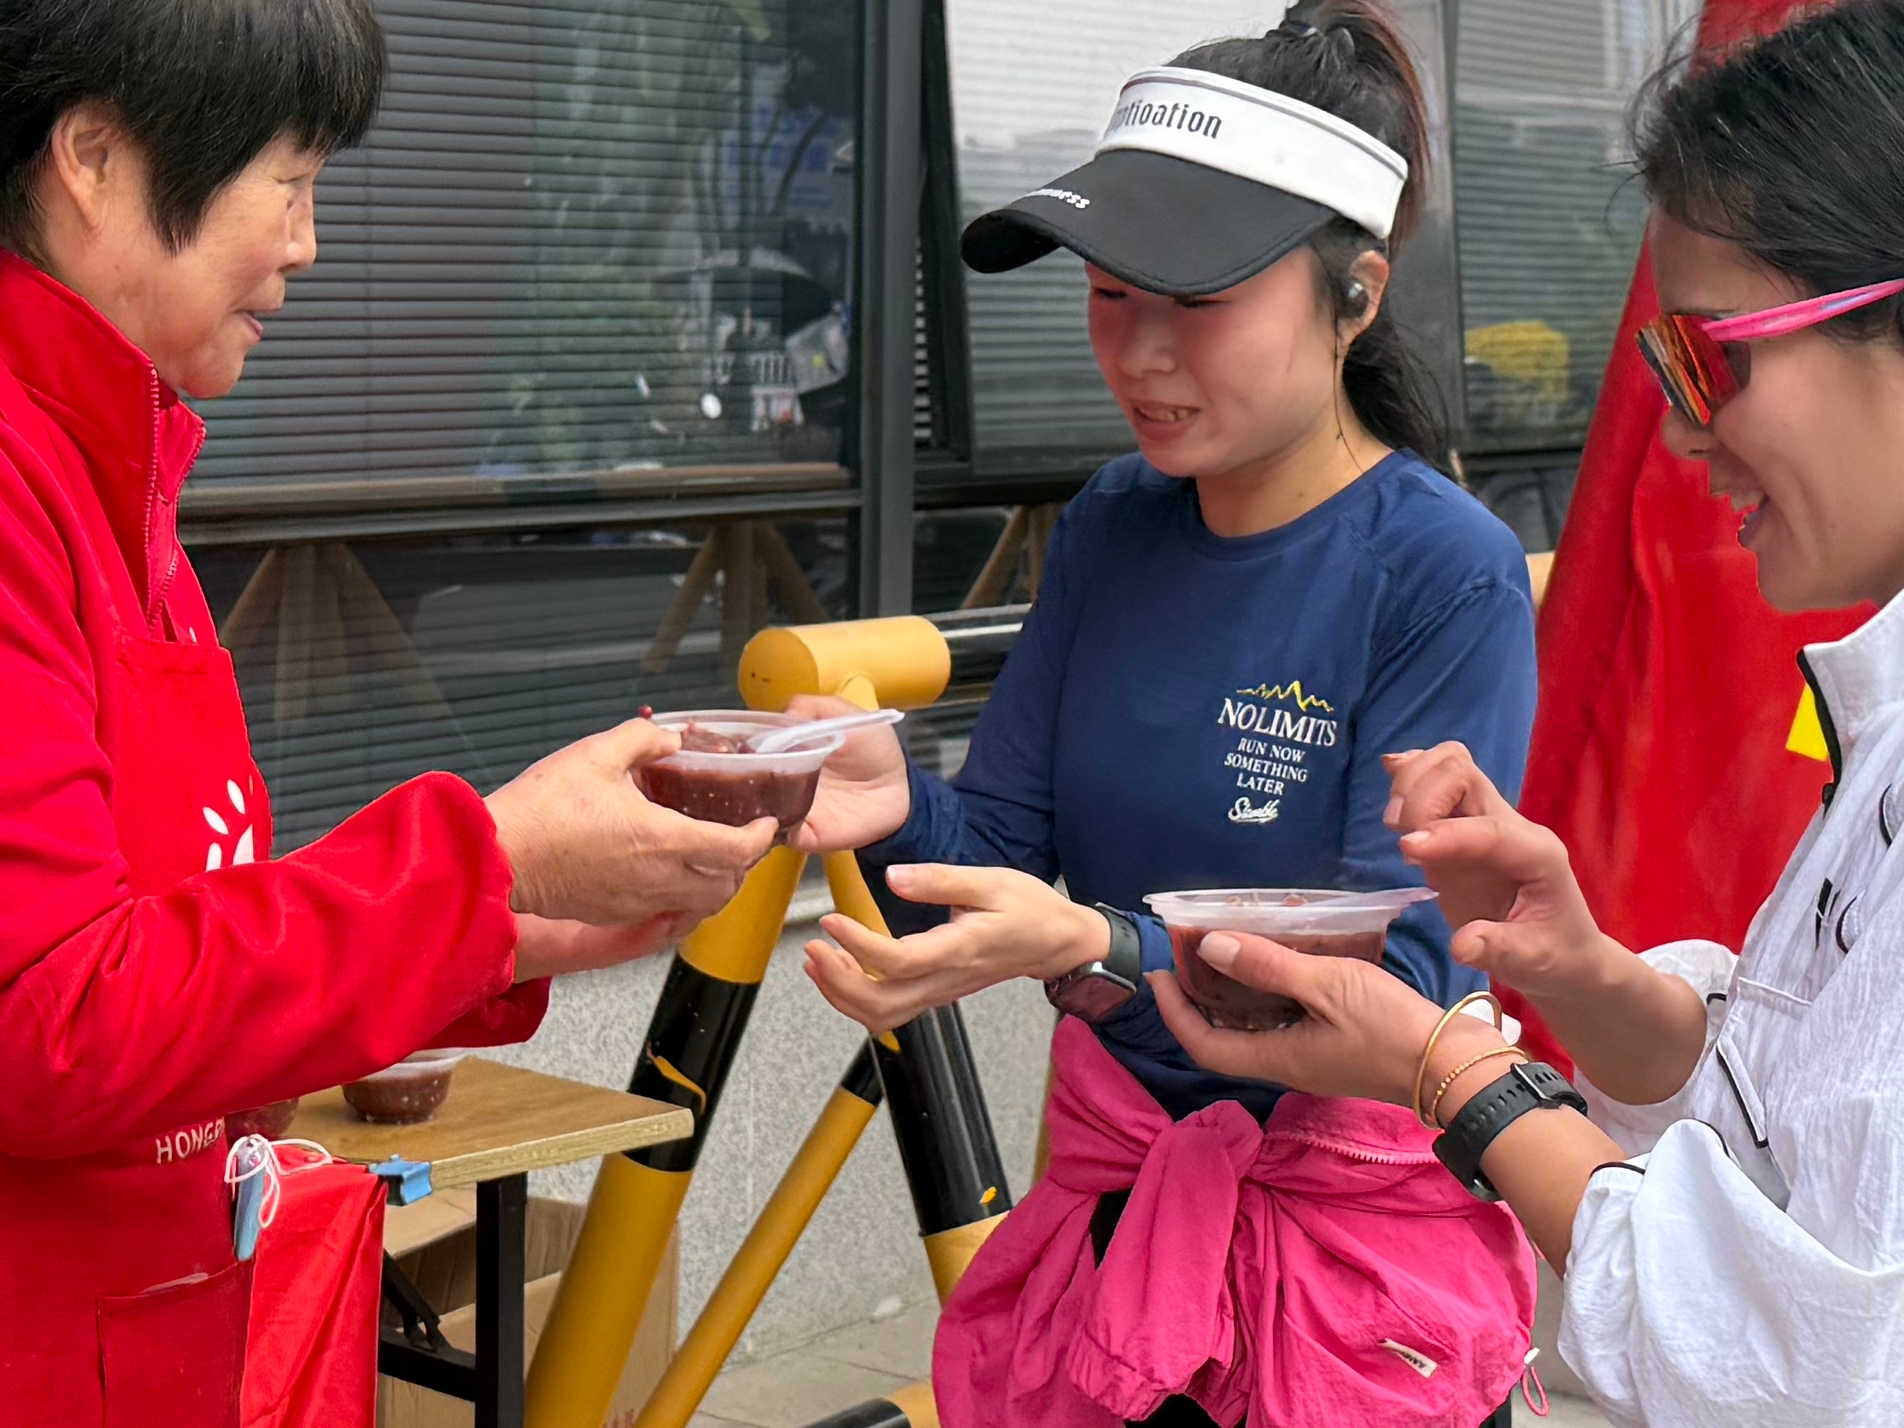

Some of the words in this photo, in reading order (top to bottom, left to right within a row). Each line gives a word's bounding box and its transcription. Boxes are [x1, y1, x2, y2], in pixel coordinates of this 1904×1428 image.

[1217, 697, 1338, 748] NOLIMITS
[1237, 737, 1268, 756] RUN
[1269, 744, 1306, 763] NOW
[1224, 752, 1308, 783] SOMETHING
[1236, 772, 1285, 796] LATER
